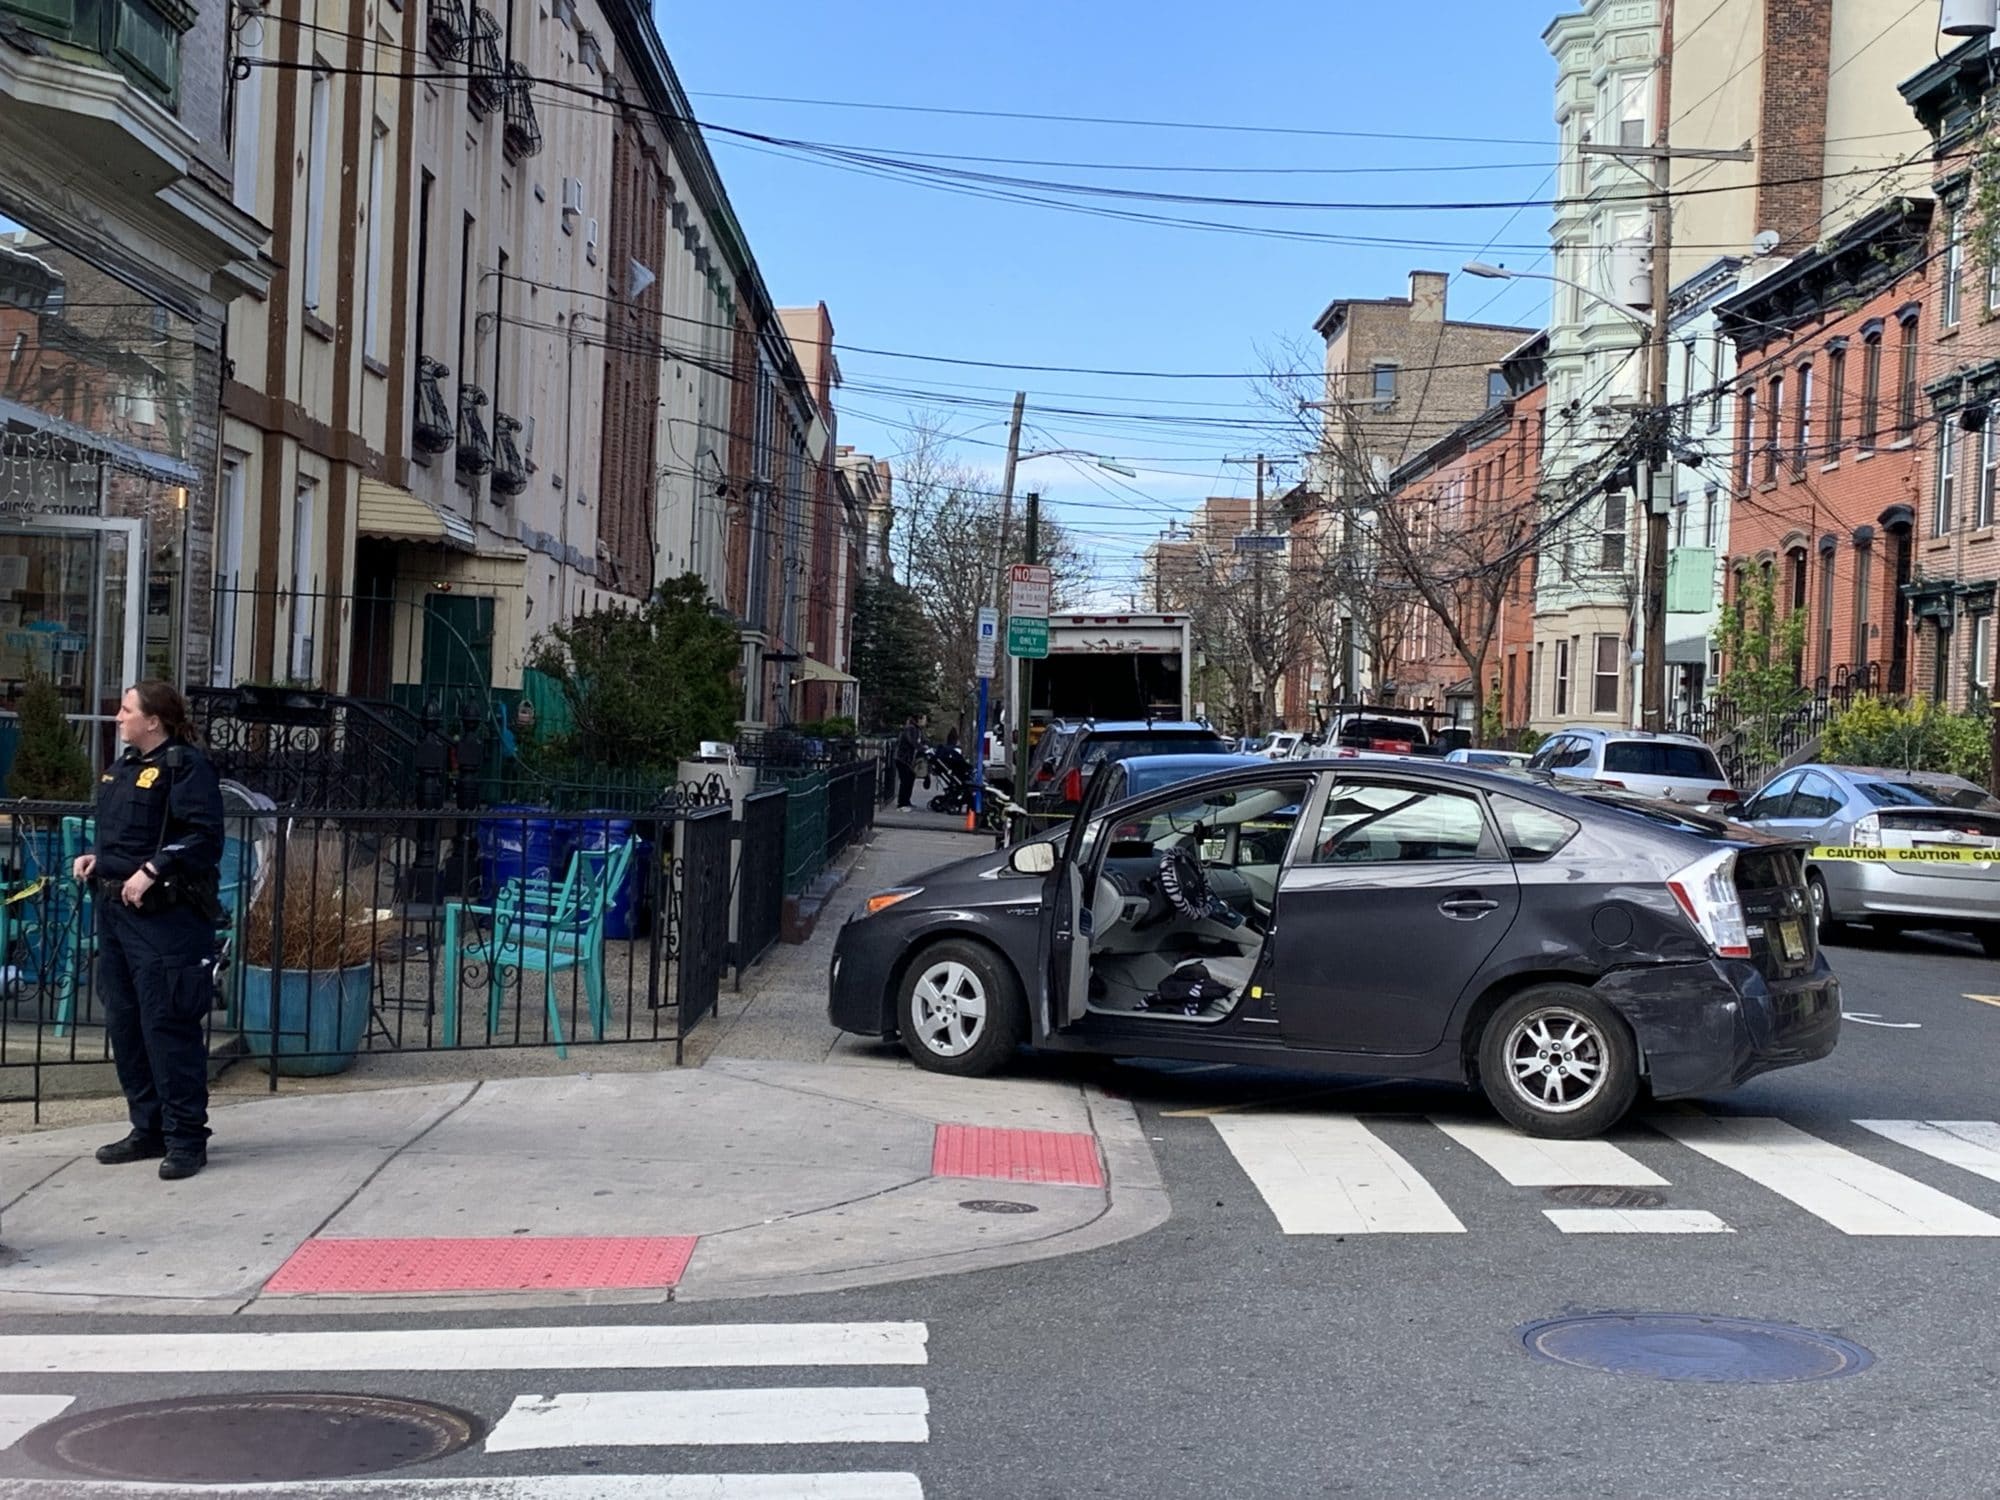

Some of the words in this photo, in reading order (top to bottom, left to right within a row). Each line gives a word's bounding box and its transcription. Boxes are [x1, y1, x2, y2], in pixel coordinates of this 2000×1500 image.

[1014, 568, 1029, 581] NO
[1019, 636, 1037, 646] ONLY
[1826, 848, 1887, 859] CAUTION
[1899, 850, 1961, 860] CAUTION
